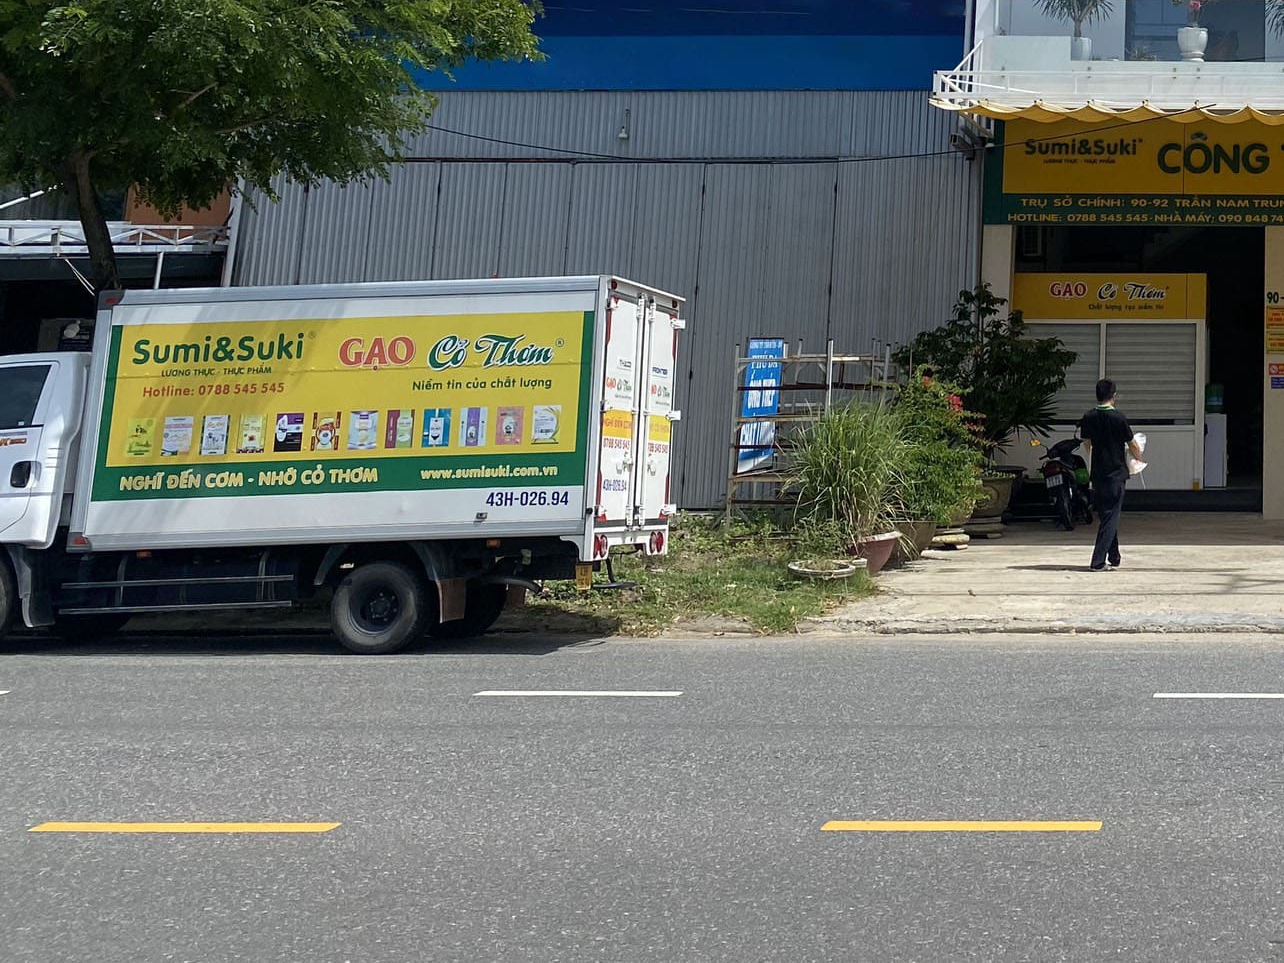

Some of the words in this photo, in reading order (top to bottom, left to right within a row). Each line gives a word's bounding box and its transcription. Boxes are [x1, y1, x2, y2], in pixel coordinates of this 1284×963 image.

[1024, 138, 1138, 156] Sumi&Suki
[1157, 131, 1271, 175] CÔNG
[1020, 198, 1048, 209] TRỤ
[1053, 195, 1073, 207] SỞ
[1078, 196, 1125, 208] CHÍNH:
[1131, 198, 1169, 208] 90-92
[1175, 193, 1211, 208] TRẦN
[1217, 199, 1250, 208] NAM
[1007, 213, 1062, 223] HOTLINE:
[1067, 213, 1097, 223] 0788
[1100, 214, 1122, 223] 545
[1218, 214, 1242, 224] 090
[1245, 215, 1269, 224] 848
[132, 332, 305, 365] Sumi&Suki
[338, 335, 417, 373] GẠO
[427, 334, 471, 371] Cỏ
[474, 332, 554, 370] Thơm
[161, 368, 191, 378] LƯƠNG
[193, 368, 216, 378] THỰC
[223, 367, 245, 377] THỰC
[247, 362, 272, 375] PHẨM
[142, 385, 195, 398] Hotline:
[198, 384, 230, 397] 0788
[234, 383, 258, 395] 545
[261, 382, 285, 394] 545
[411, 378, 444, 391] Niềm
[446, 378, 463, 391] tin
[465, 377, 487, 390] của
[490, 376, 516, 389] chất
[519, 375, 553, 390] lượng
[119, 470, 166, 492] NGHĨ
[166, 468, 202, 491] ĐẾN
[204, 470, 244, 489] CƠM
[258, 467, 298, 487] NHỚ
[300, 463, 326, 486] CỎ
[328, 466, 379, 485] THƠM
[420, 463, 559, 481] www.sumisuki.com.vn
[485, 490, 570, 508] 43H-026.94
